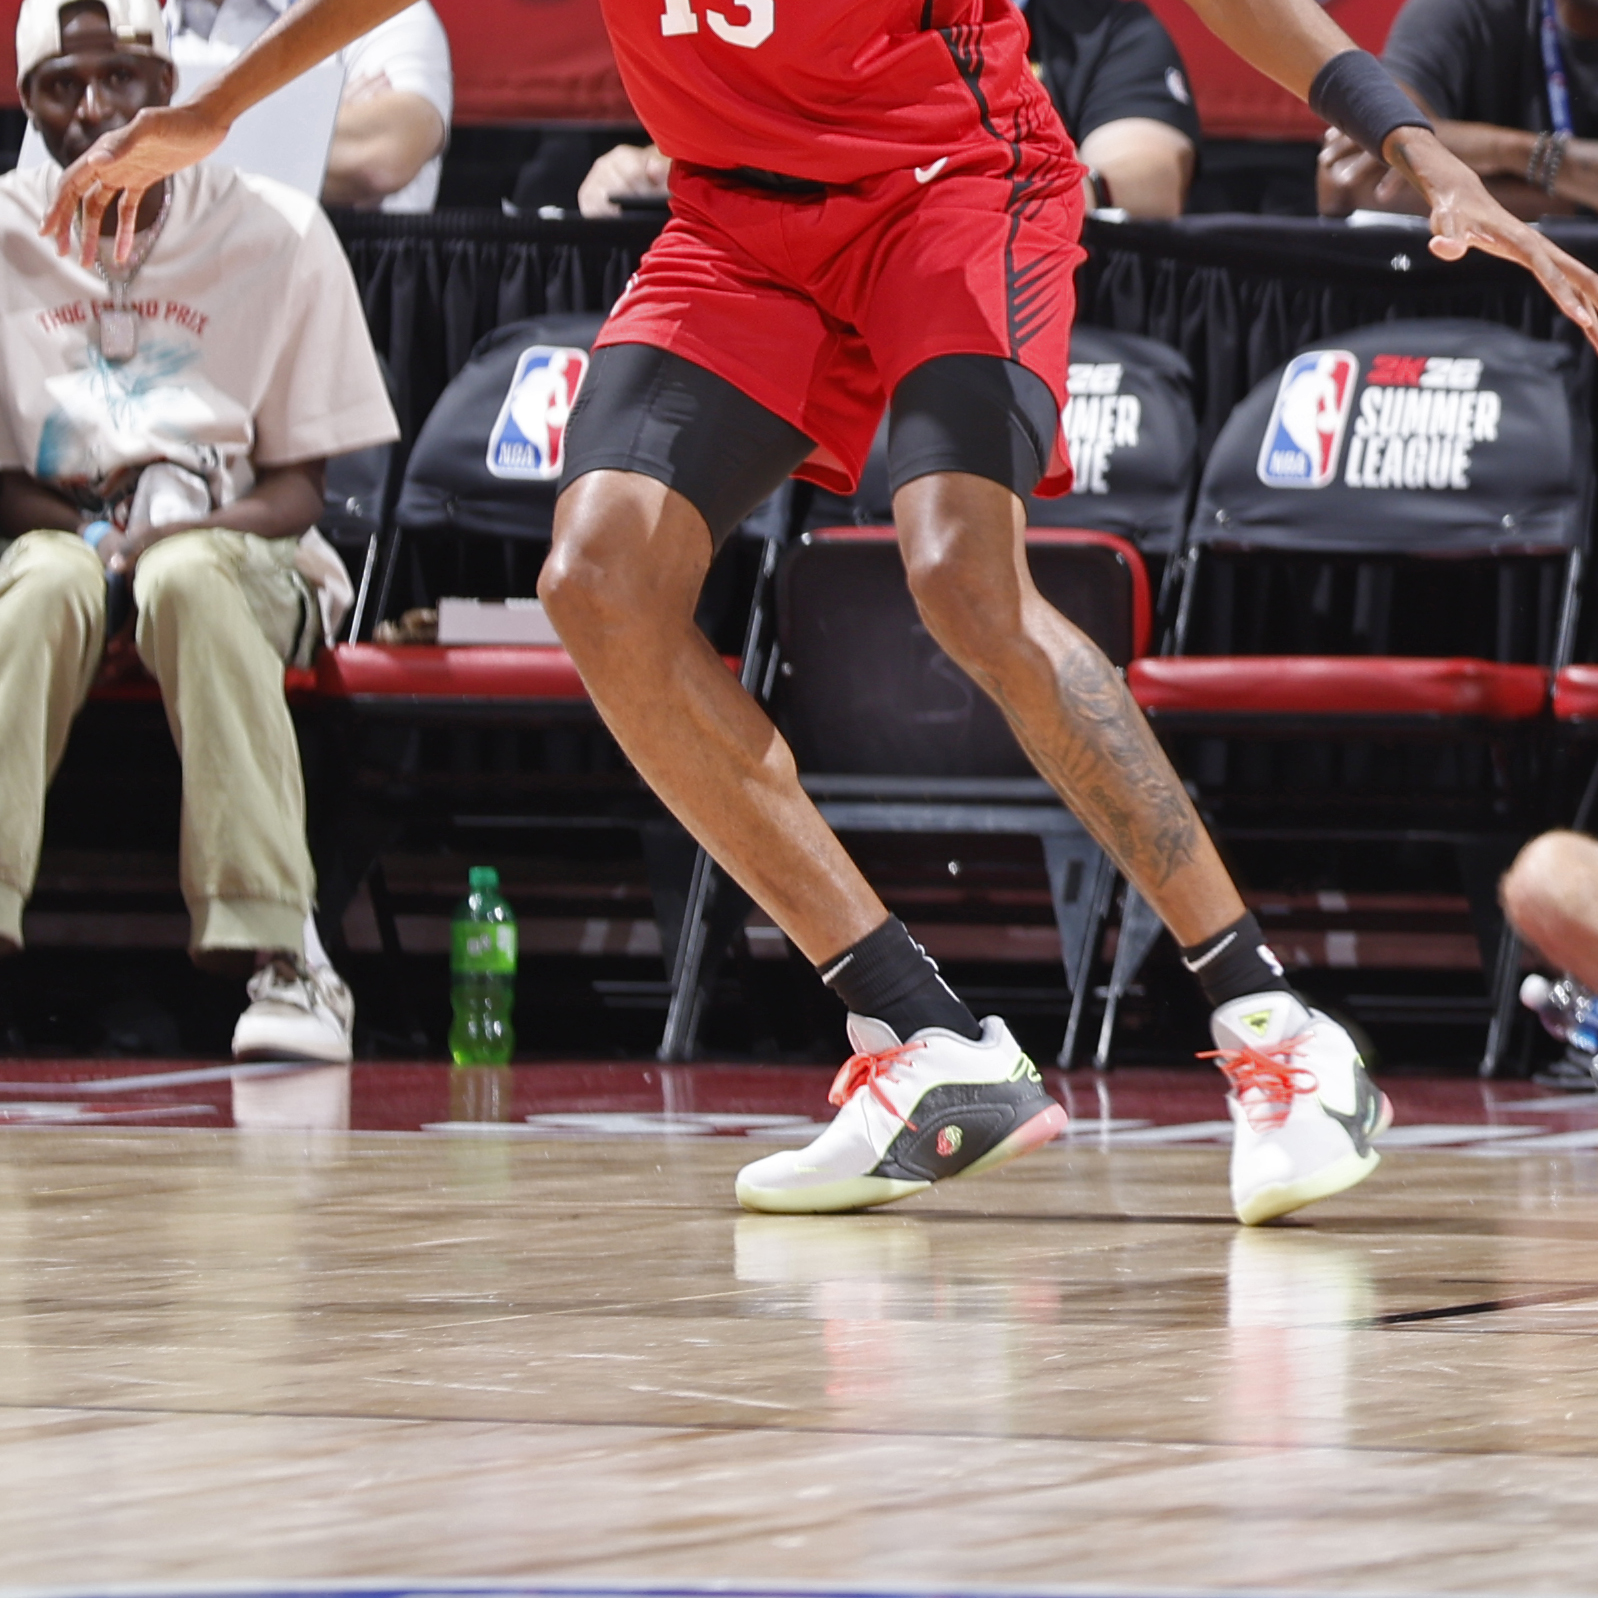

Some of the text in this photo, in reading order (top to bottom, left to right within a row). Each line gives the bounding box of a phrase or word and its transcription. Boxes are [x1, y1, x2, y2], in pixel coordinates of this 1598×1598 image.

[1066, 362, 1123, 395] 26
[1366, 354, 1484, 390] 2K26
[1355, 385, 1502, 443] SUMMER
[498, 442, 535, 467] NBA
[1269, 451, 1308, 476] NBA
[1344, 434, 1474, 490] LEAGUE
